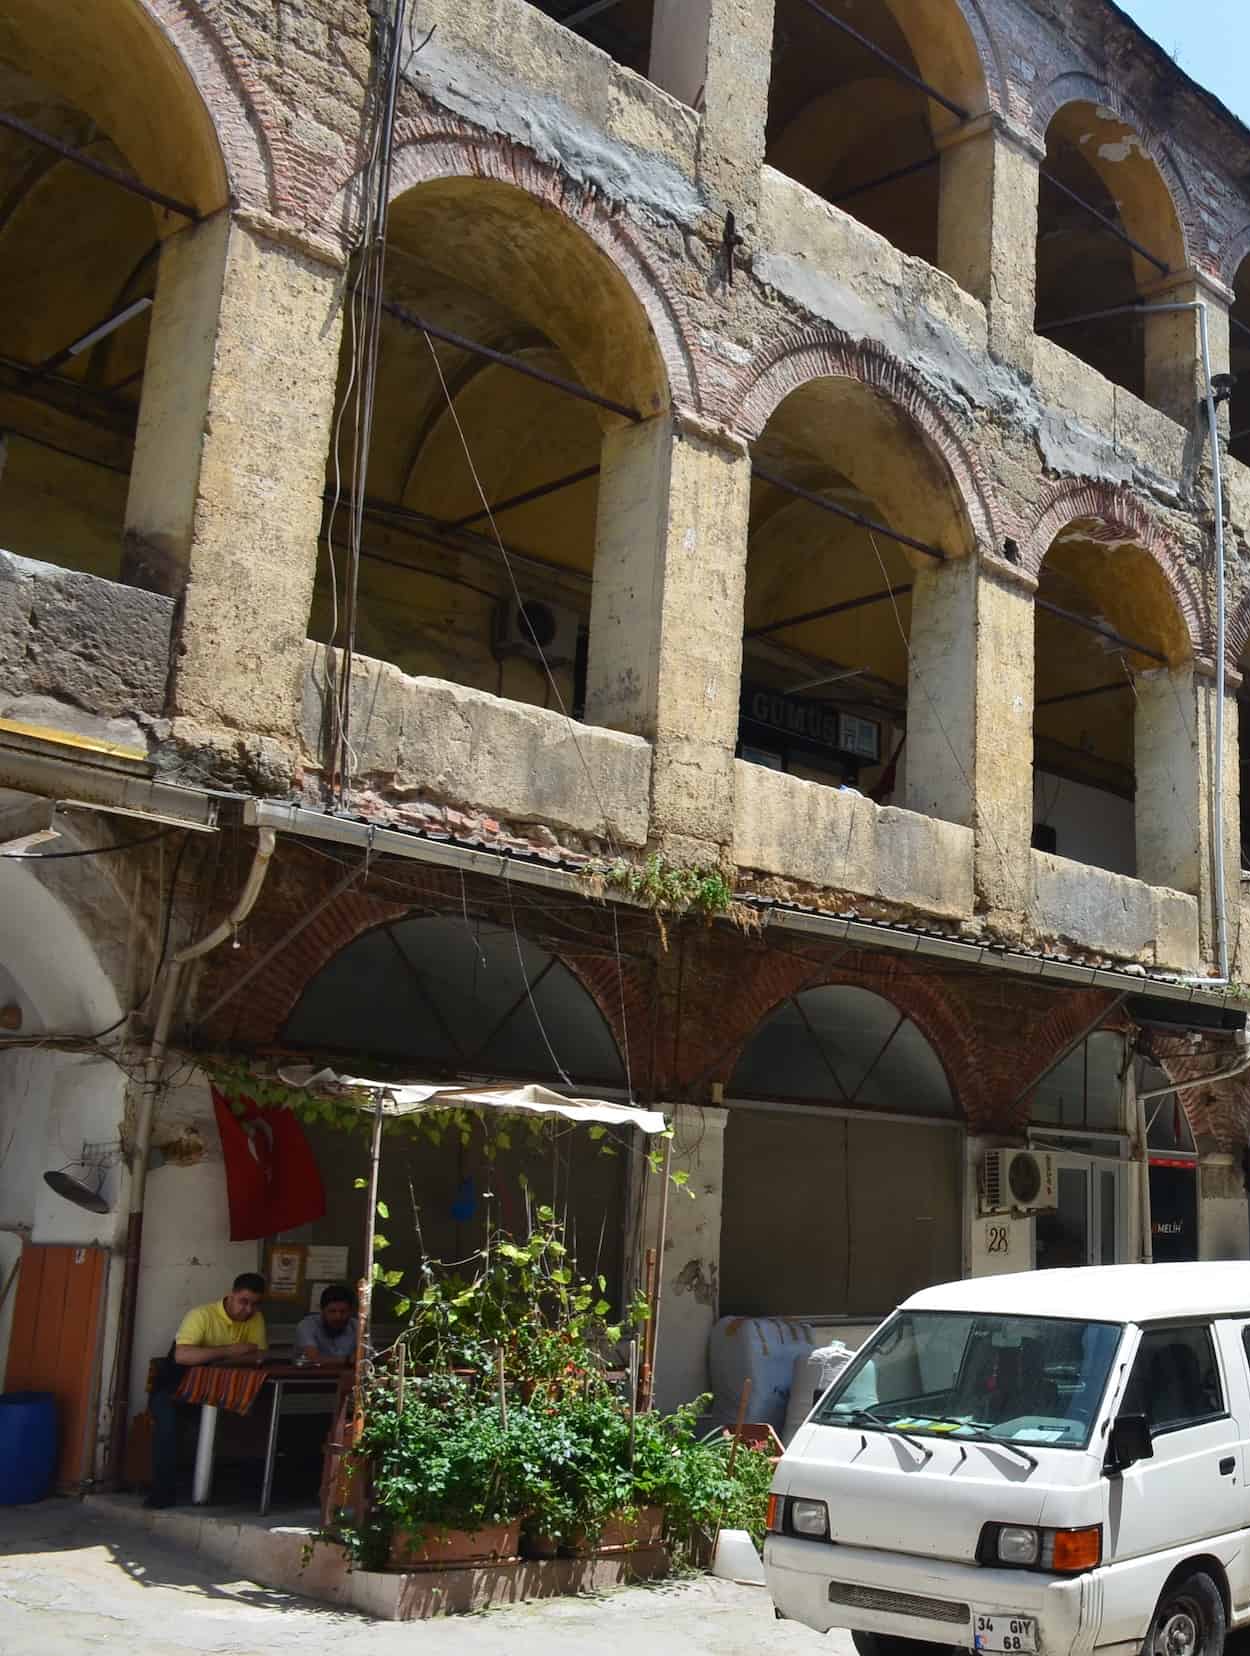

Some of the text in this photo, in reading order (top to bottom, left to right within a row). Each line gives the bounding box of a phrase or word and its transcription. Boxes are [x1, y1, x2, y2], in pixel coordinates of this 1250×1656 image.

[988, 1227, 1009, 1252] 28
[978, 1617, 1031, 1634] 34 GIY
[1003, 1636, 1021, 1650] 68
